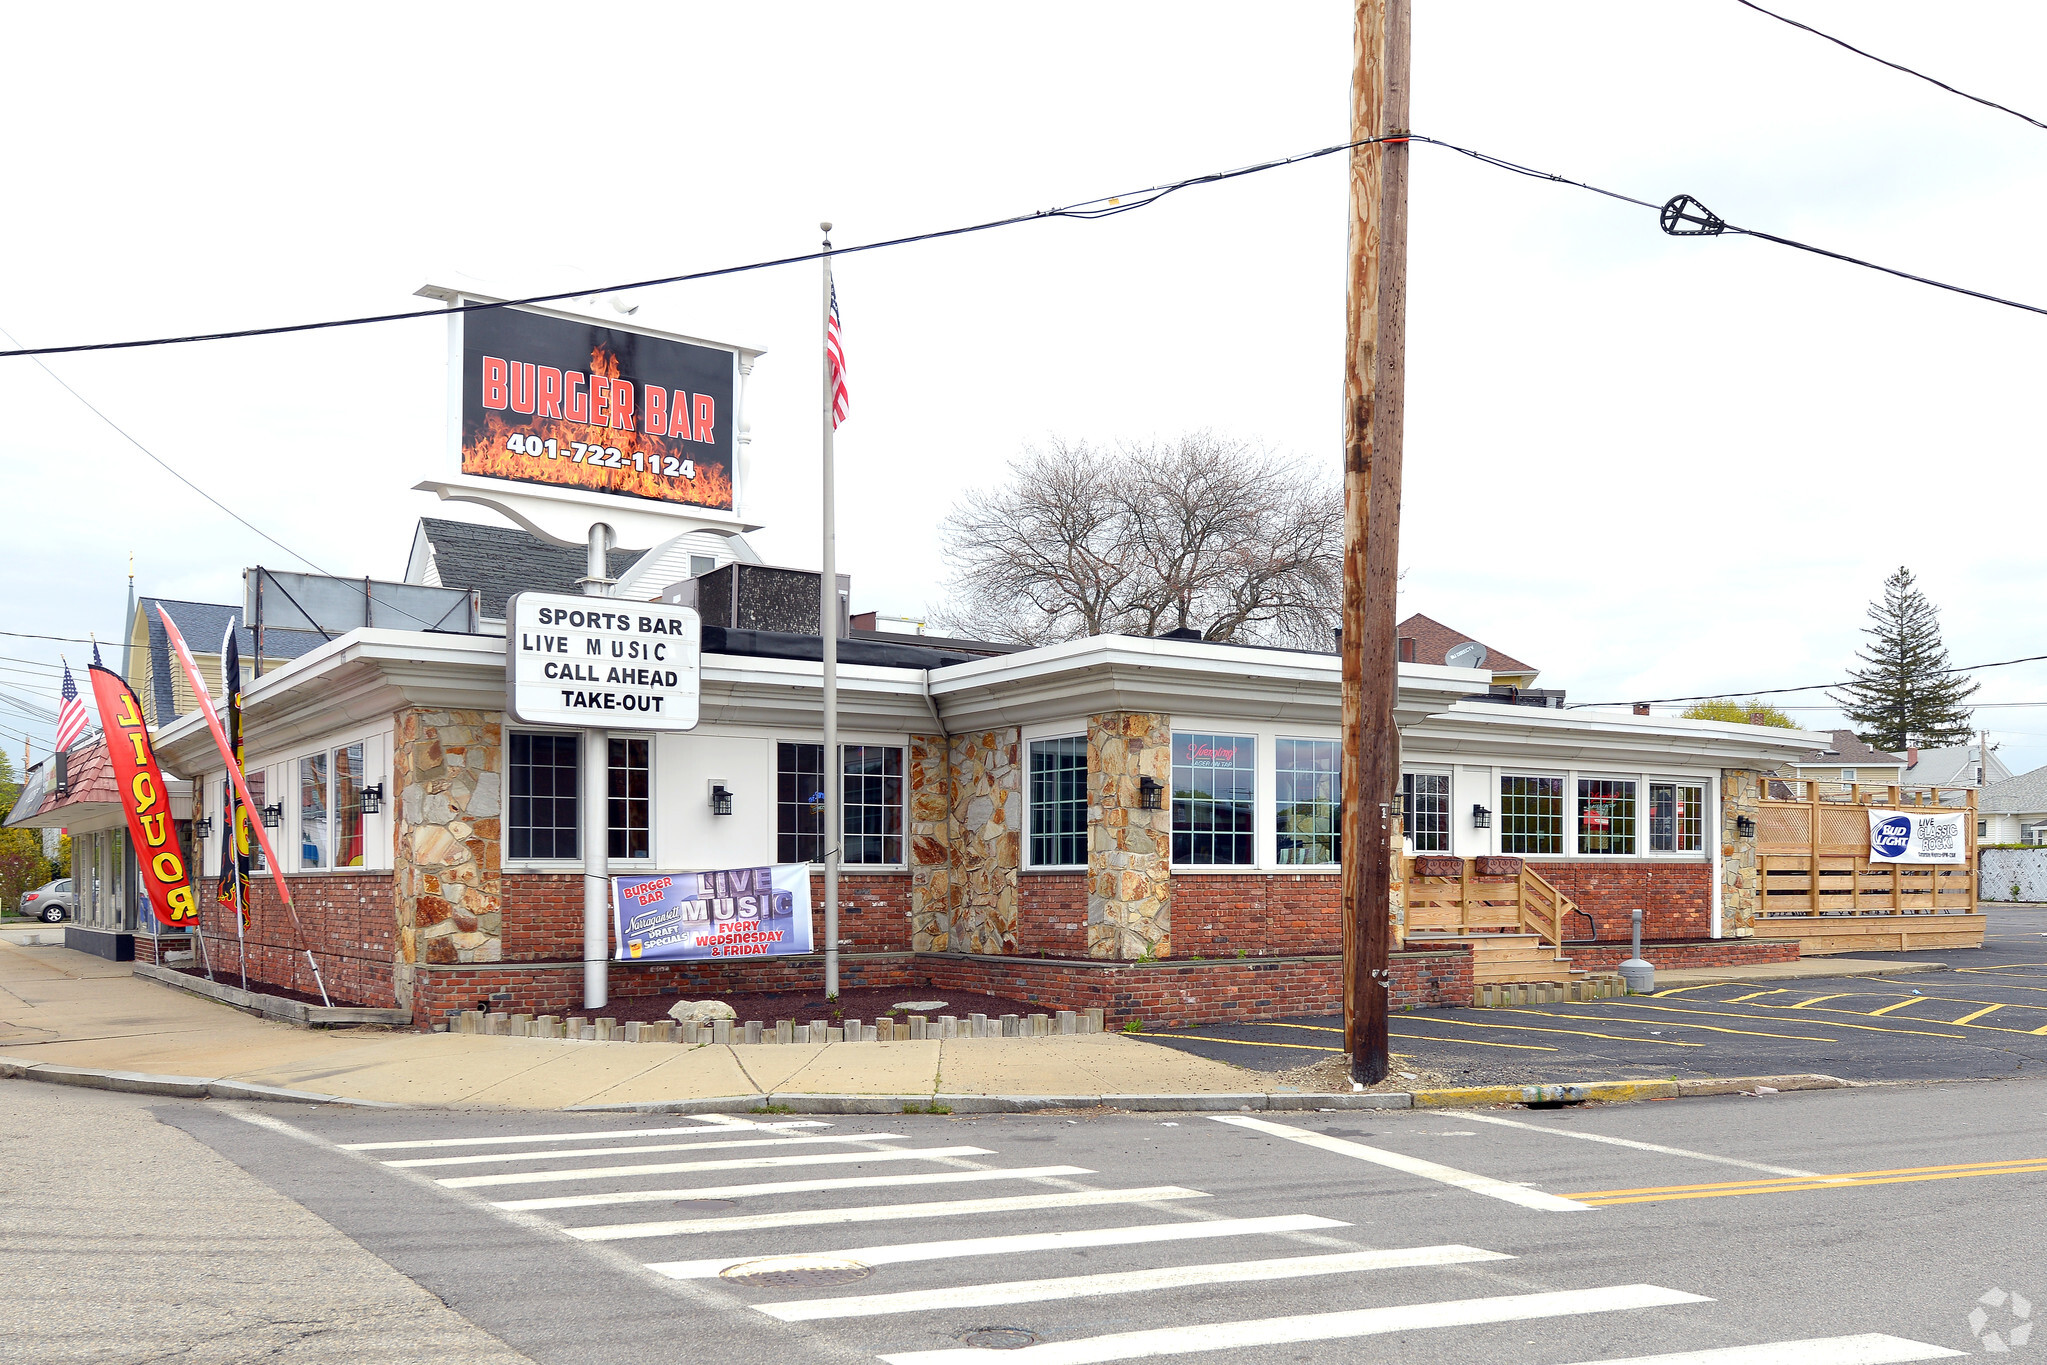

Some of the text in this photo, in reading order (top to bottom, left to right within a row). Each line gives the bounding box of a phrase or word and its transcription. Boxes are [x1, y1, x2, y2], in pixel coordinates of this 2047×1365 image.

[482, 356, 715, 445] BURGER BAR
[506, 433, 696, 480] 401-722-1124
[538, 607, 683, 636] SPORTS BAR
[523, 633, 667, 661] LIVE MUSIC
[544, 662, 678, 687] CALL AHEAD
[561, 690, 664, 713] TAKE-OUT
[1882, 824, 1907, 836] BUD
[1917, 823, 1959, 840] CLASSIC
[1919, 818, 1935, 827] LIVE
[1876, 836, 1909, 847] LIGHT
[1921, 836, 1954, 852] ROCK!
[698, 869, 771, 895] LIVE
[639, 890, 665, 906] BAR
[681, 893, 793, 920] MUSIC
[625, 906, 681, 934] Narragansett
[648, 925, 679, 938] DRAFT
[711, 943, 769, 957] & FRIDAY
